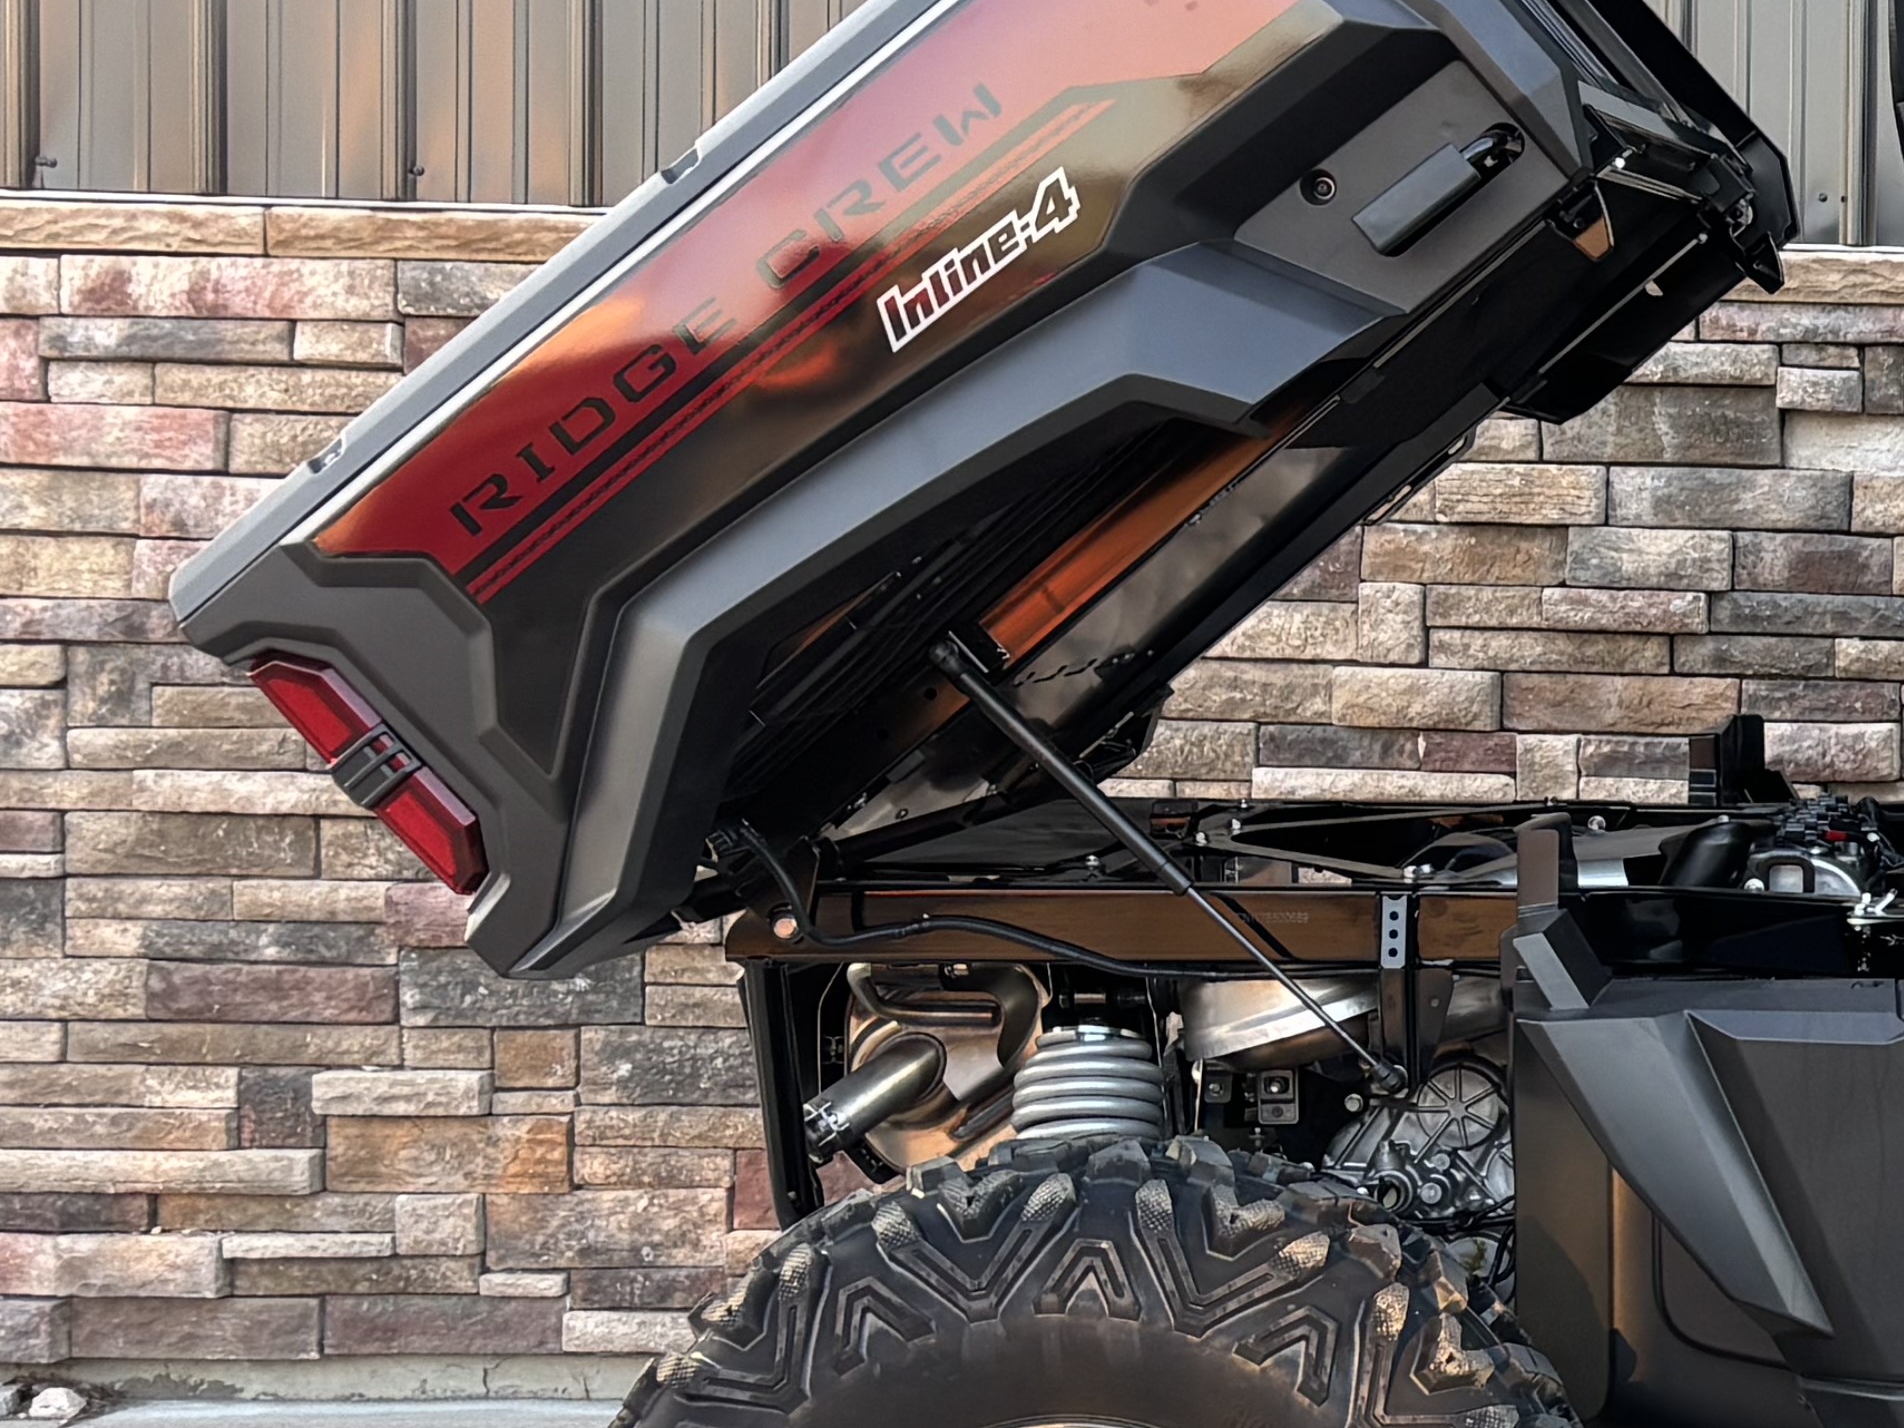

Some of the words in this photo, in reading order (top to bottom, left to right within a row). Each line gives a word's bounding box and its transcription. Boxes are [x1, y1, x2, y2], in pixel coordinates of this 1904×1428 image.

[450, 294, 735, 536] RIDGE
[754, 83, 1002, 288] CREW
[876, 165, 1081, 353] Inline-4
